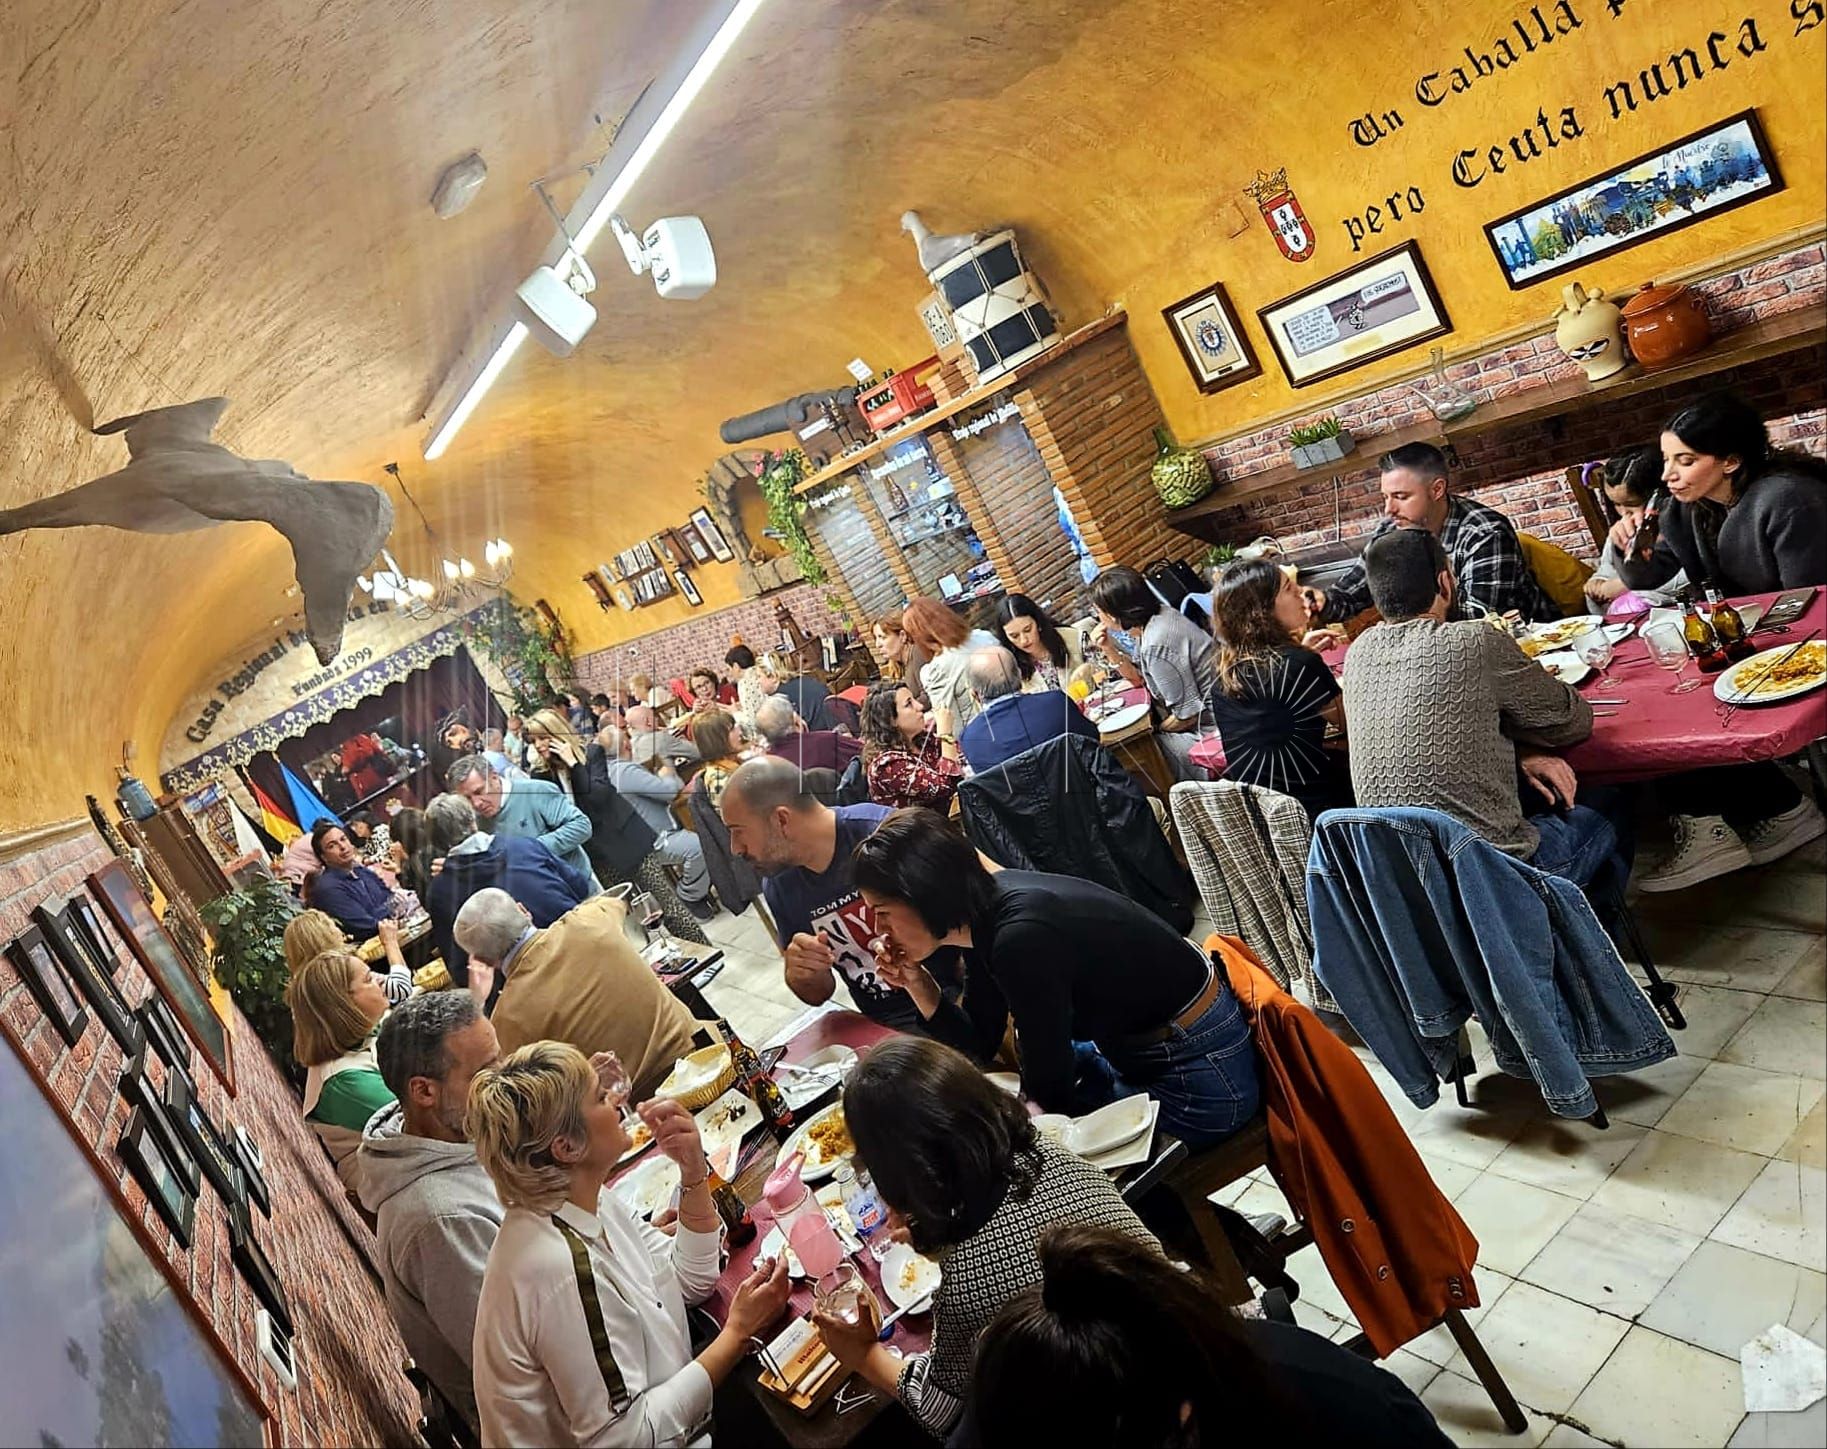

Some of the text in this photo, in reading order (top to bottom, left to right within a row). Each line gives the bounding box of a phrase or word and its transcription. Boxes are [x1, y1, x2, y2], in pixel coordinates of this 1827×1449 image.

[1347, 0, 1584, 147] Un Caballa
[1342, 186, 1425, 252] pero
[1452, 106, 1585, 188] Ceuta
[1602, 18, 1768, 119] nunca
[186, 699, 225, 743] Casa
[217, 638, 288, 702] Regional
[291, 646, 373, 697] Fundada 1999
[810, 889, 860, 917] TOMMY
